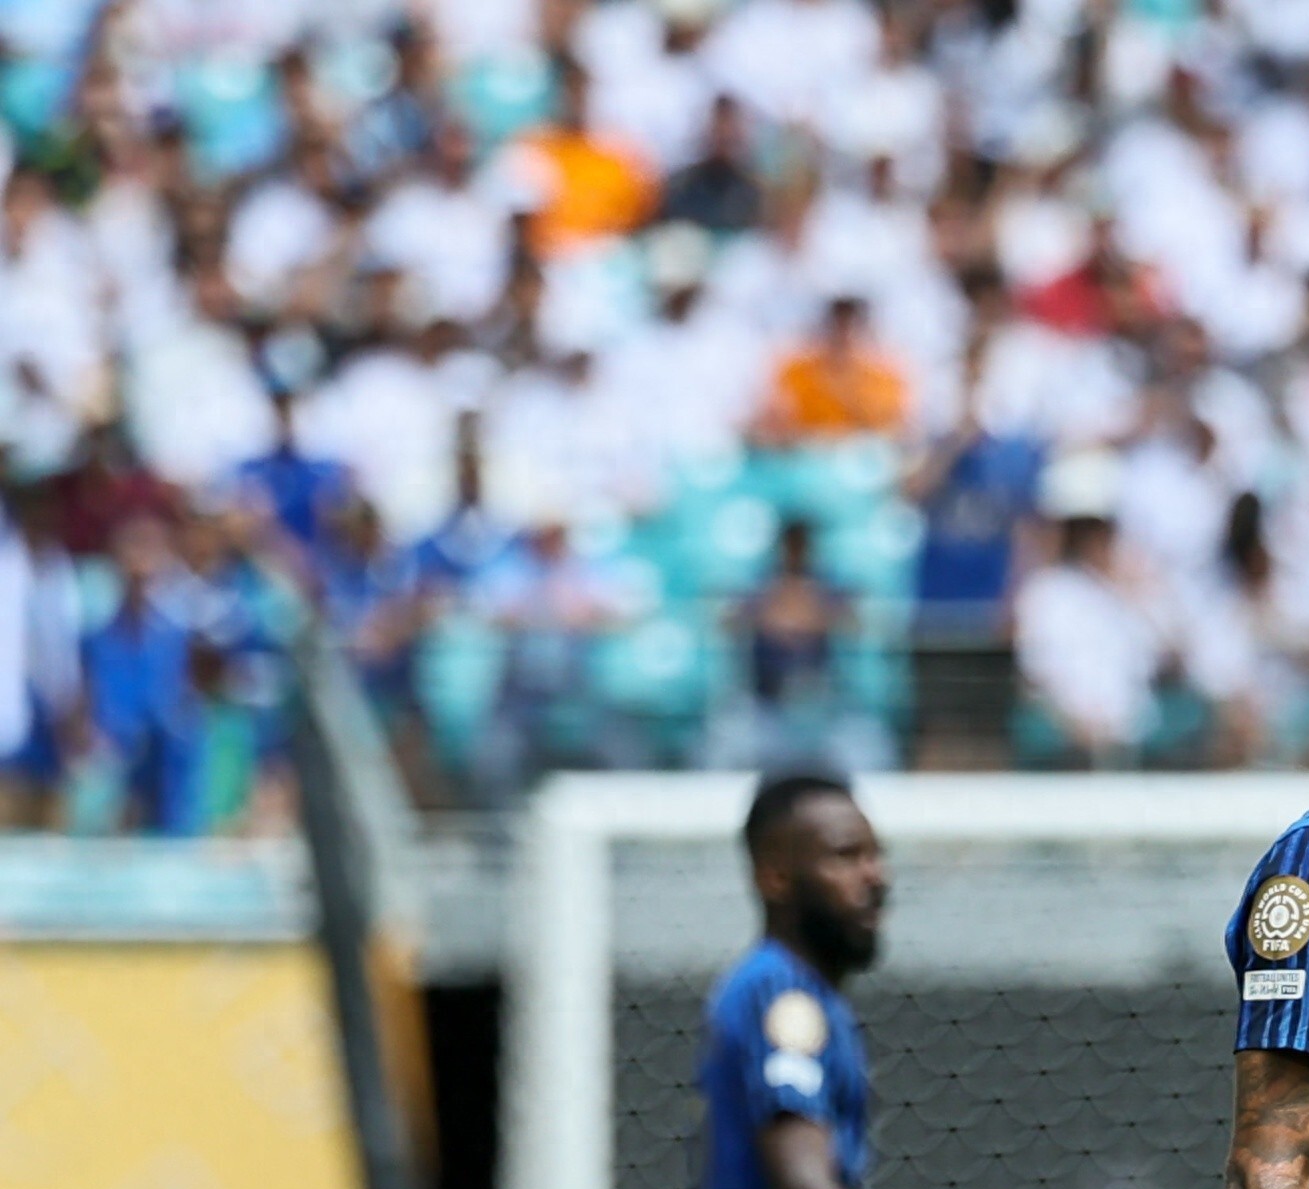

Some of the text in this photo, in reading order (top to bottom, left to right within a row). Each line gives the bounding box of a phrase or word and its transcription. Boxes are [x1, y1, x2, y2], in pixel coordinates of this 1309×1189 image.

[1258, 883, 1287, 909] WORLD
[1288, 884, 1308, 900] CUP
[1262, 939, 1290, 952] FIFA
